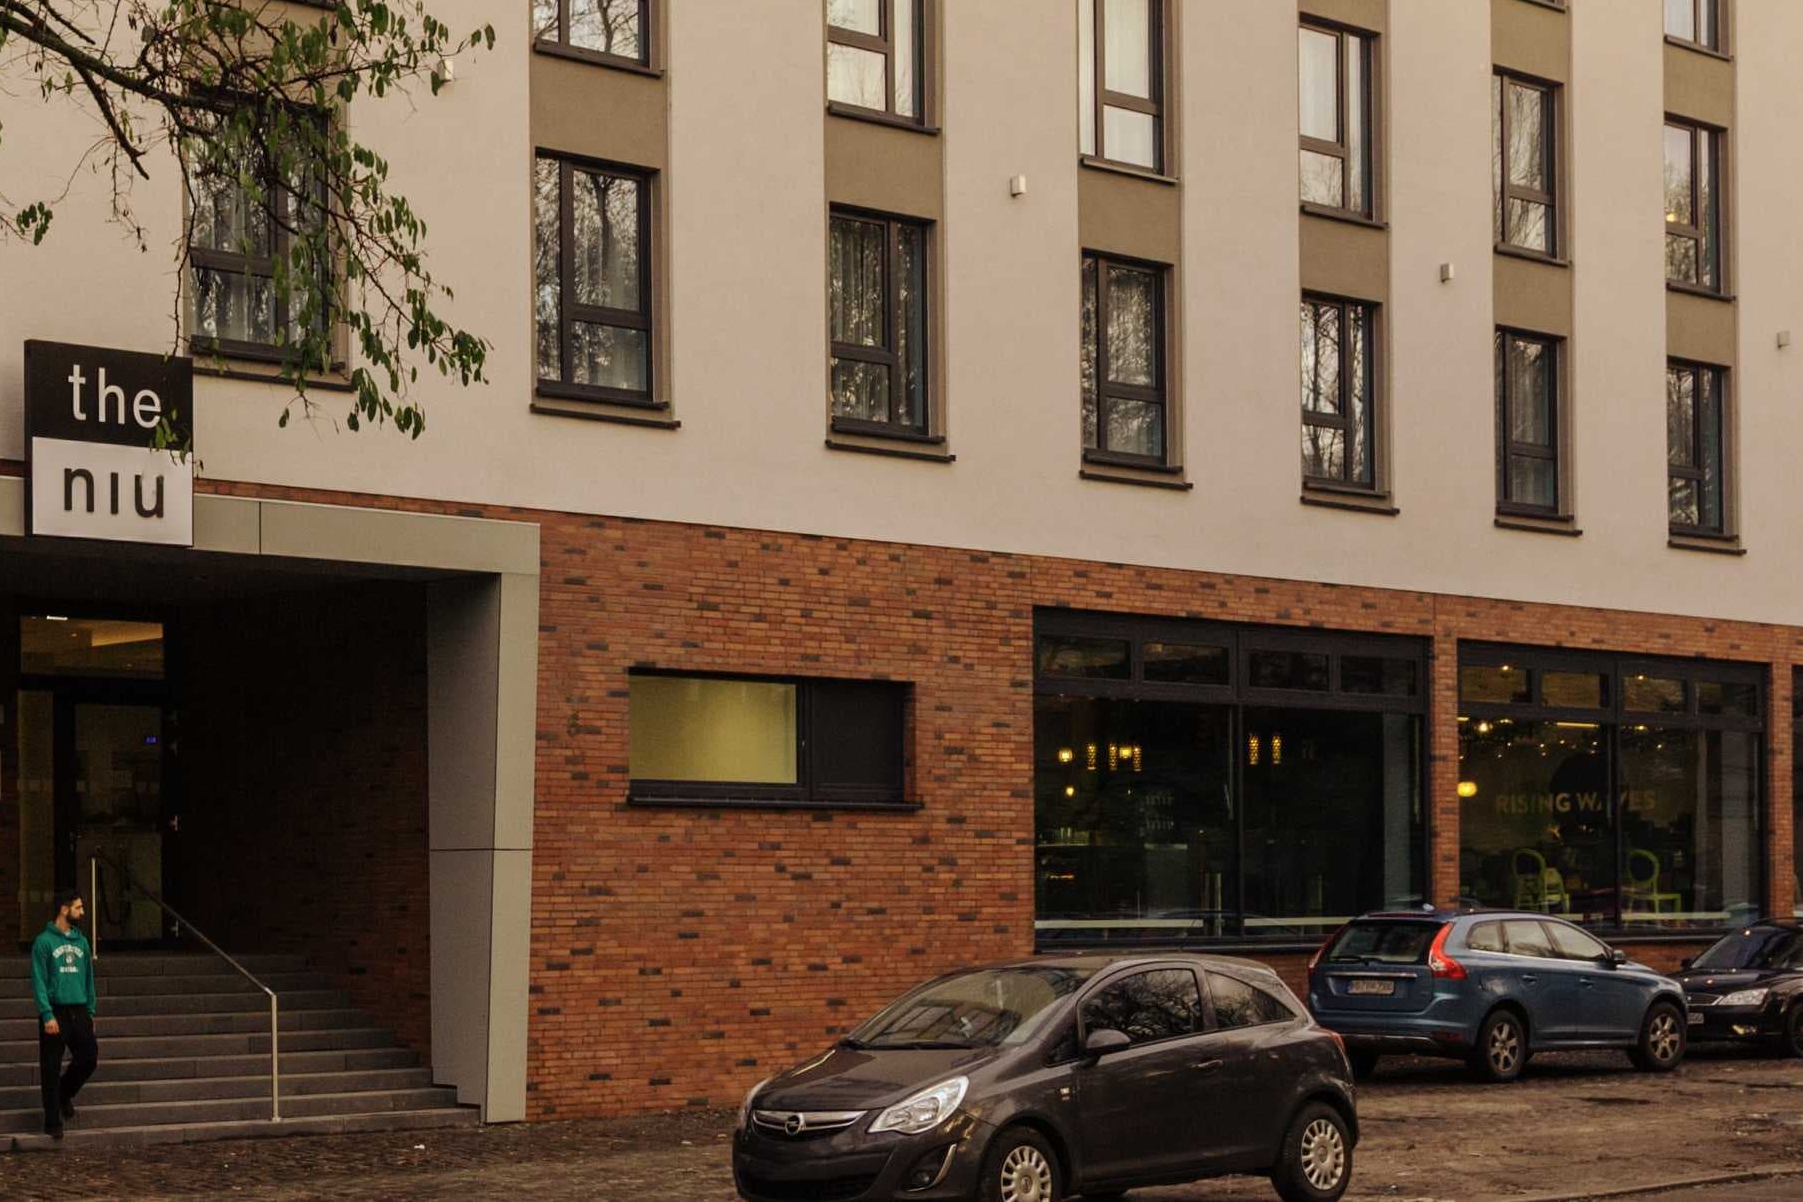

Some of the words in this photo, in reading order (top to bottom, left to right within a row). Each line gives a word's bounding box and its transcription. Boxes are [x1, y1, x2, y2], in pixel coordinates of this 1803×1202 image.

[68, 364, 161, 428] the
[64, 467, 164, 518] niu
[1497, 792, 1572, 813] RISING
